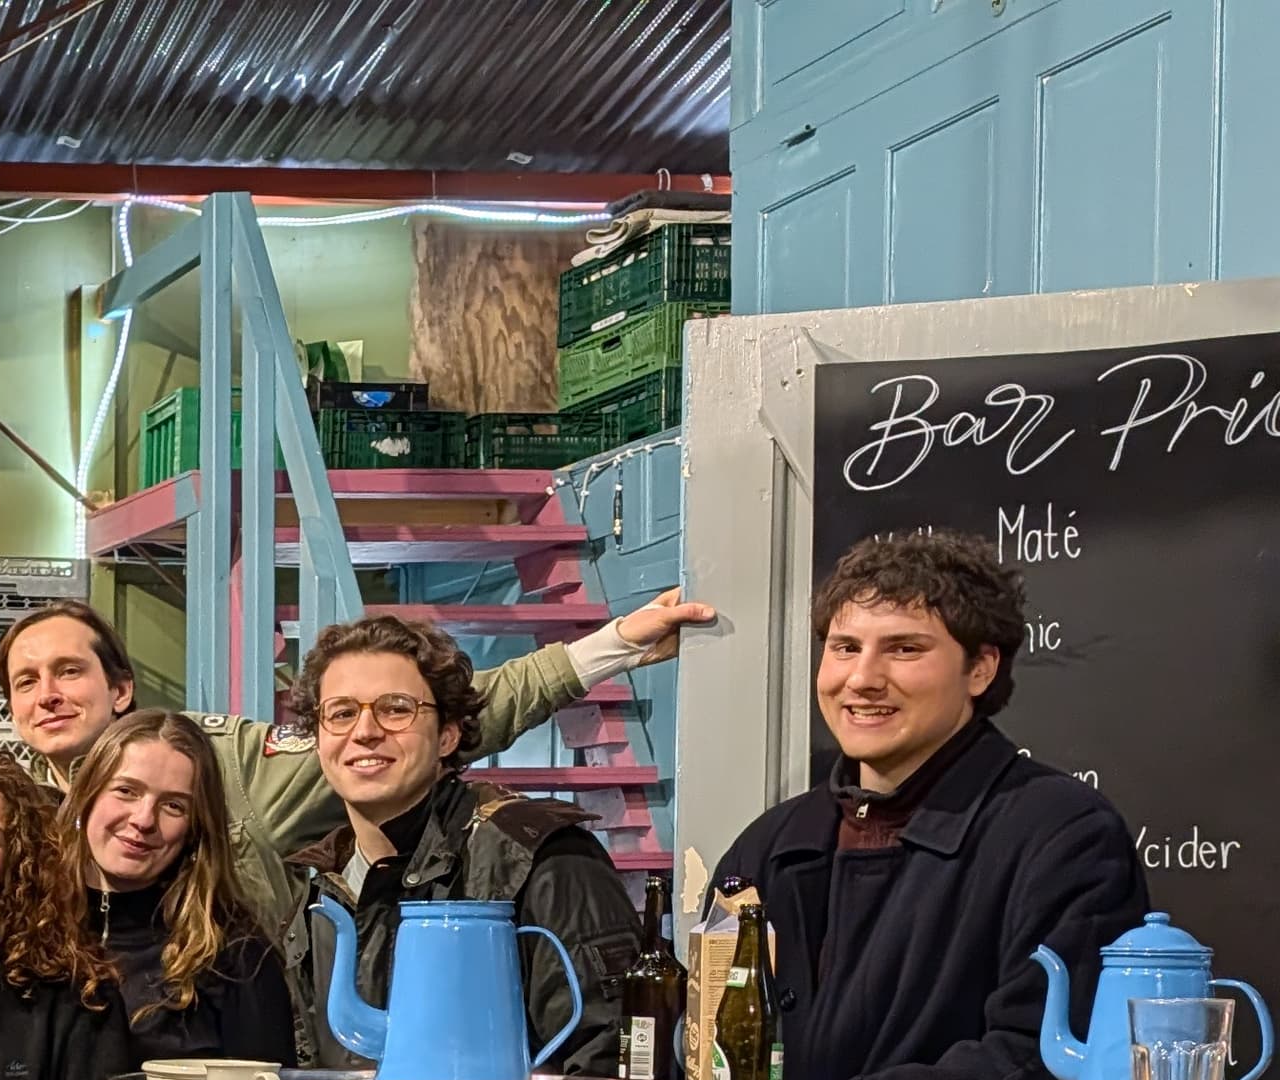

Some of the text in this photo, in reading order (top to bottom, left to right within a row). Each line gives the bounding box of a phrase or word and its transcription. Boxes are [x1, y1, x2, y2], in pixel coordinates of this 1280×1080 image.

[843, 374, 1076, 491] Bar
[998, 502, 1082, 564] Maté
[1024, 615, 1062, 653] nic
